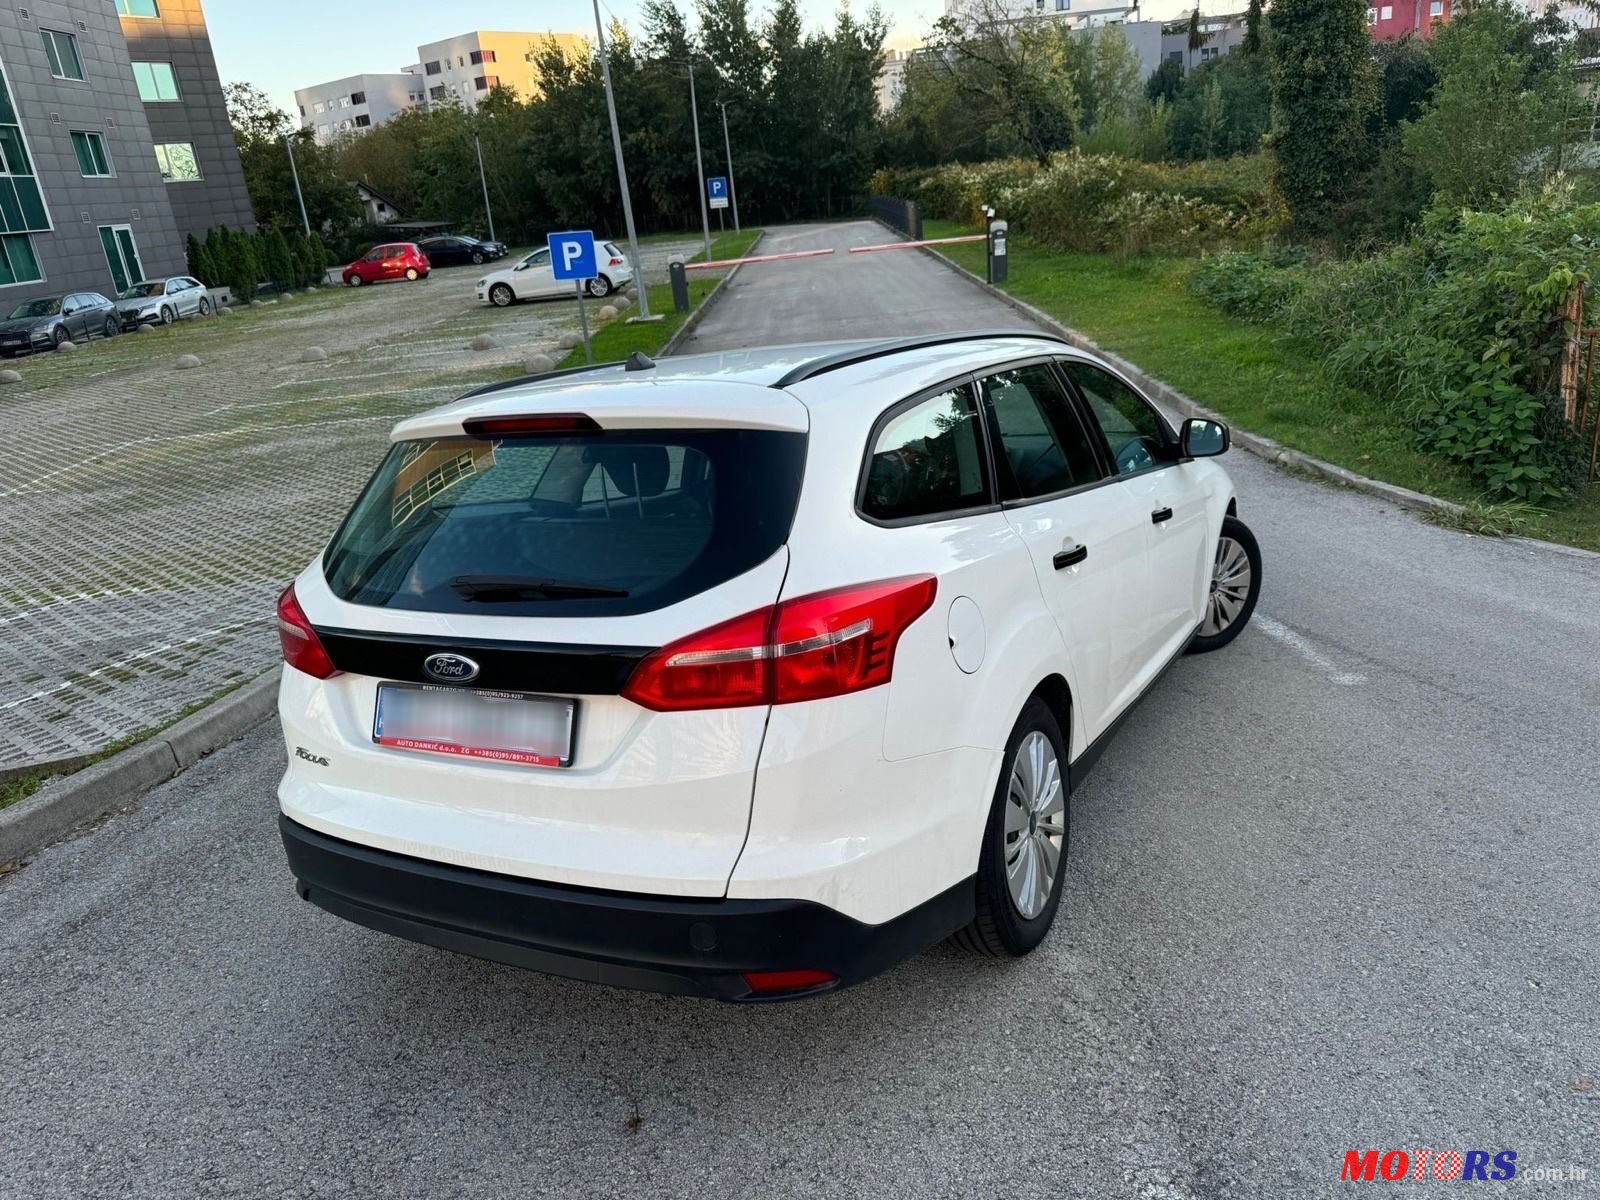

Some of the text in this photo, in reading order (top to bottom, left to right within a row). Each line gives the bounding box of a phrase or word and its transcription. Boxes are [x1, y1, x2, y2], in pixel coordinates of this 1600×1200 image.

[713, 182, 721, 194] P
[562, 241, 582, 271] P
[434, 657, 464, 674] Ford
[397, 739, 413, 748] AUTO
